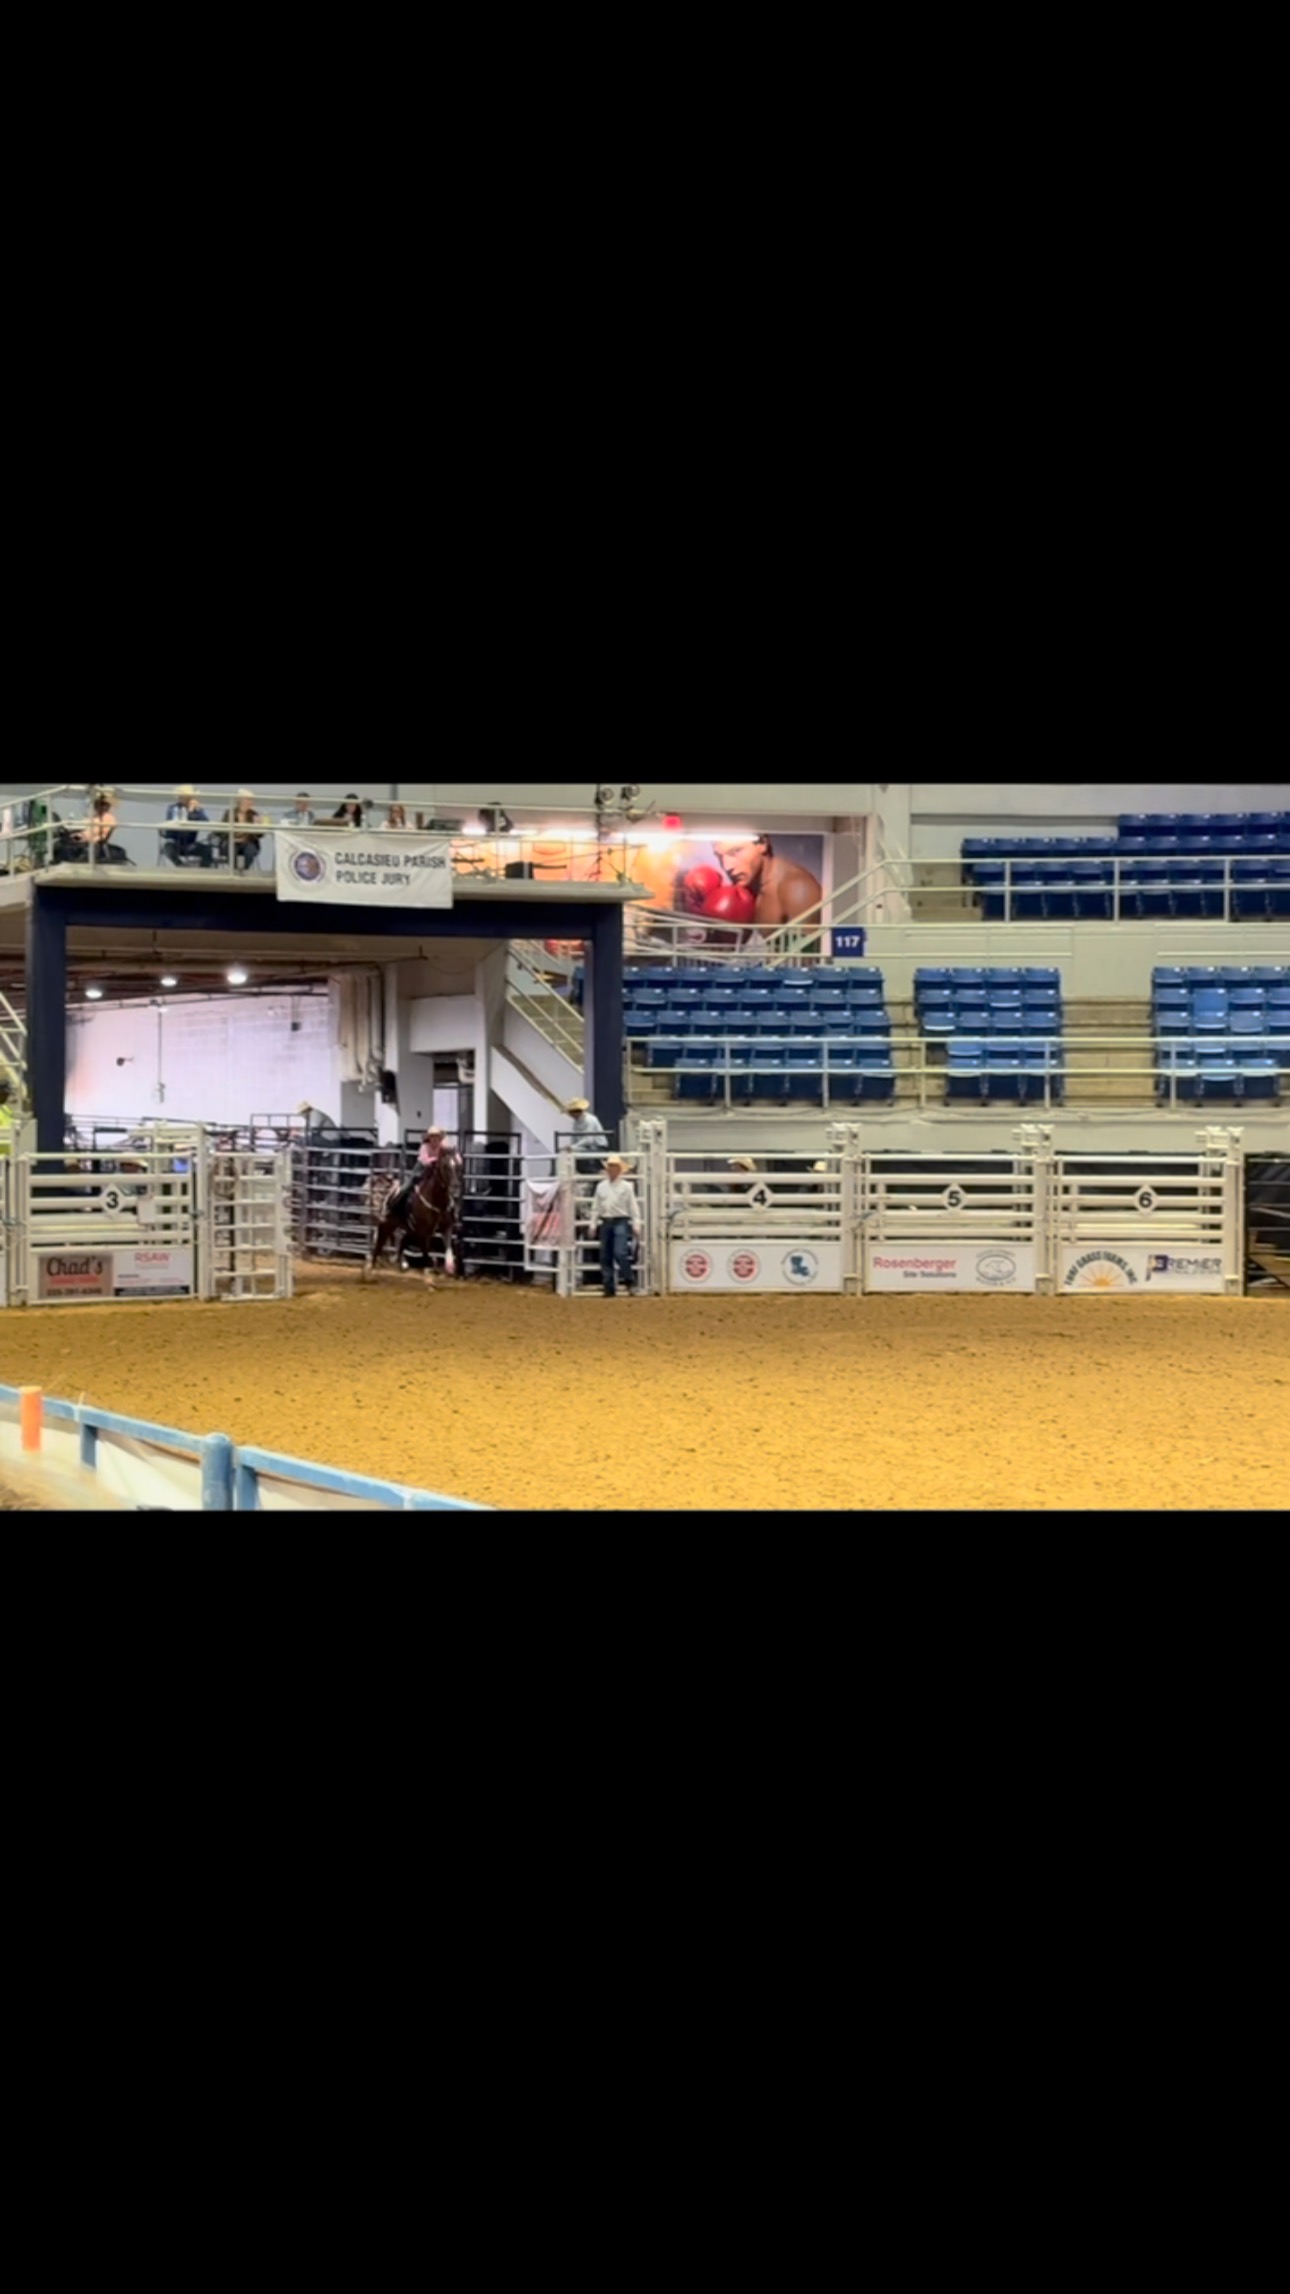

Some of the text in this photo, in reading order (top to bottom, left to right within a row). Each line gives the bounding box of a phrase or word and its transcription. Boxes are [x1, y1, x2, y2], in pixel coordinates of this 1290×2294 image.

[335, 852, 400, 867] CALCASIEU
[404, 855, 446, 869] PARISH
[336, 870, 410, 885] POLICE JURY
[836, 936, 860, 948] 117
[106, 1191, 119, 1209] 3
[753, 1189, 767, 1206] 4
[947, 1190, 961, 1207] 5
[1139, 1192, 1152, 1208] 6
[47, 1256, 103, 1276] Chad's
[873, 1257, 956, 1271] Rosenberger
